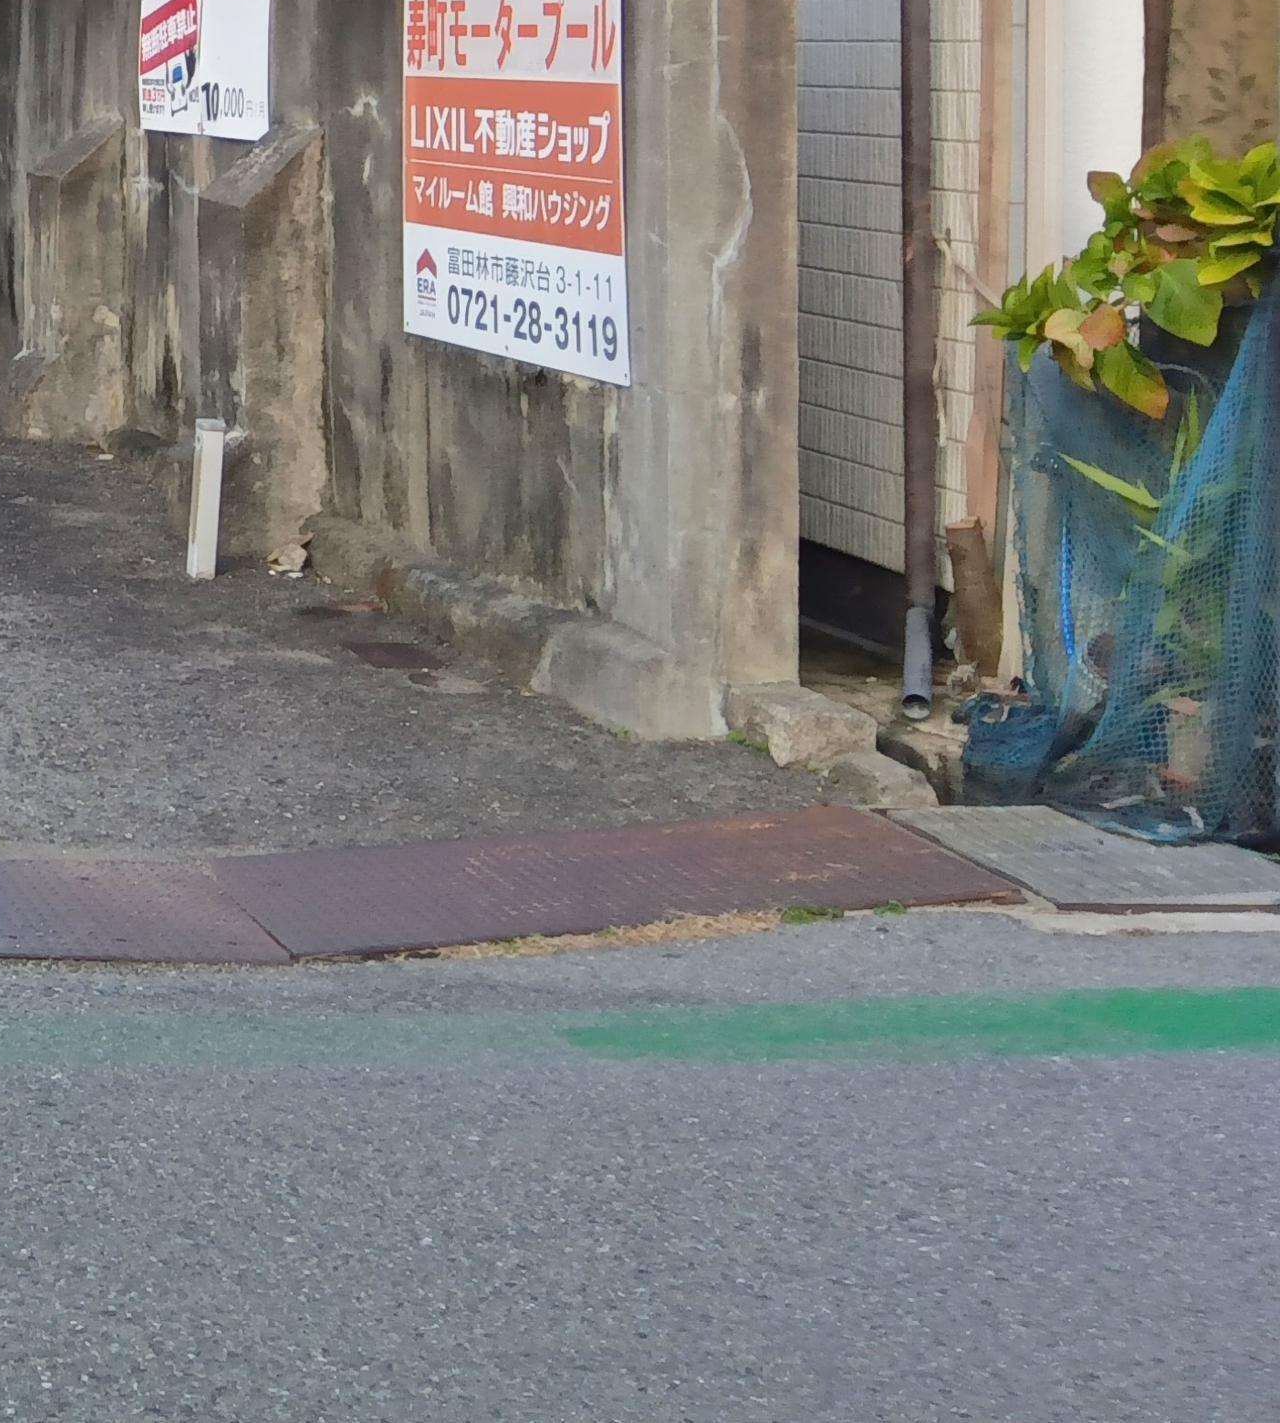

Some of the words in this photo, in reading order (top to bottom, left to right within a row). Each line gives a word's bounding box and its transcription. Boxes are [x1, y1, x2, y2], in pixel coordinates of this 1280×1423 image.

[410, 104, 611, 164] LIXIL不動産ショップ
[412, 175, 494, 217] マイルーム館
[502, 183, 611, 231] 興和ハウジング
[416, 277, 437, 297] ERA
[447, 284, 618, 362] 0721-28-3119
